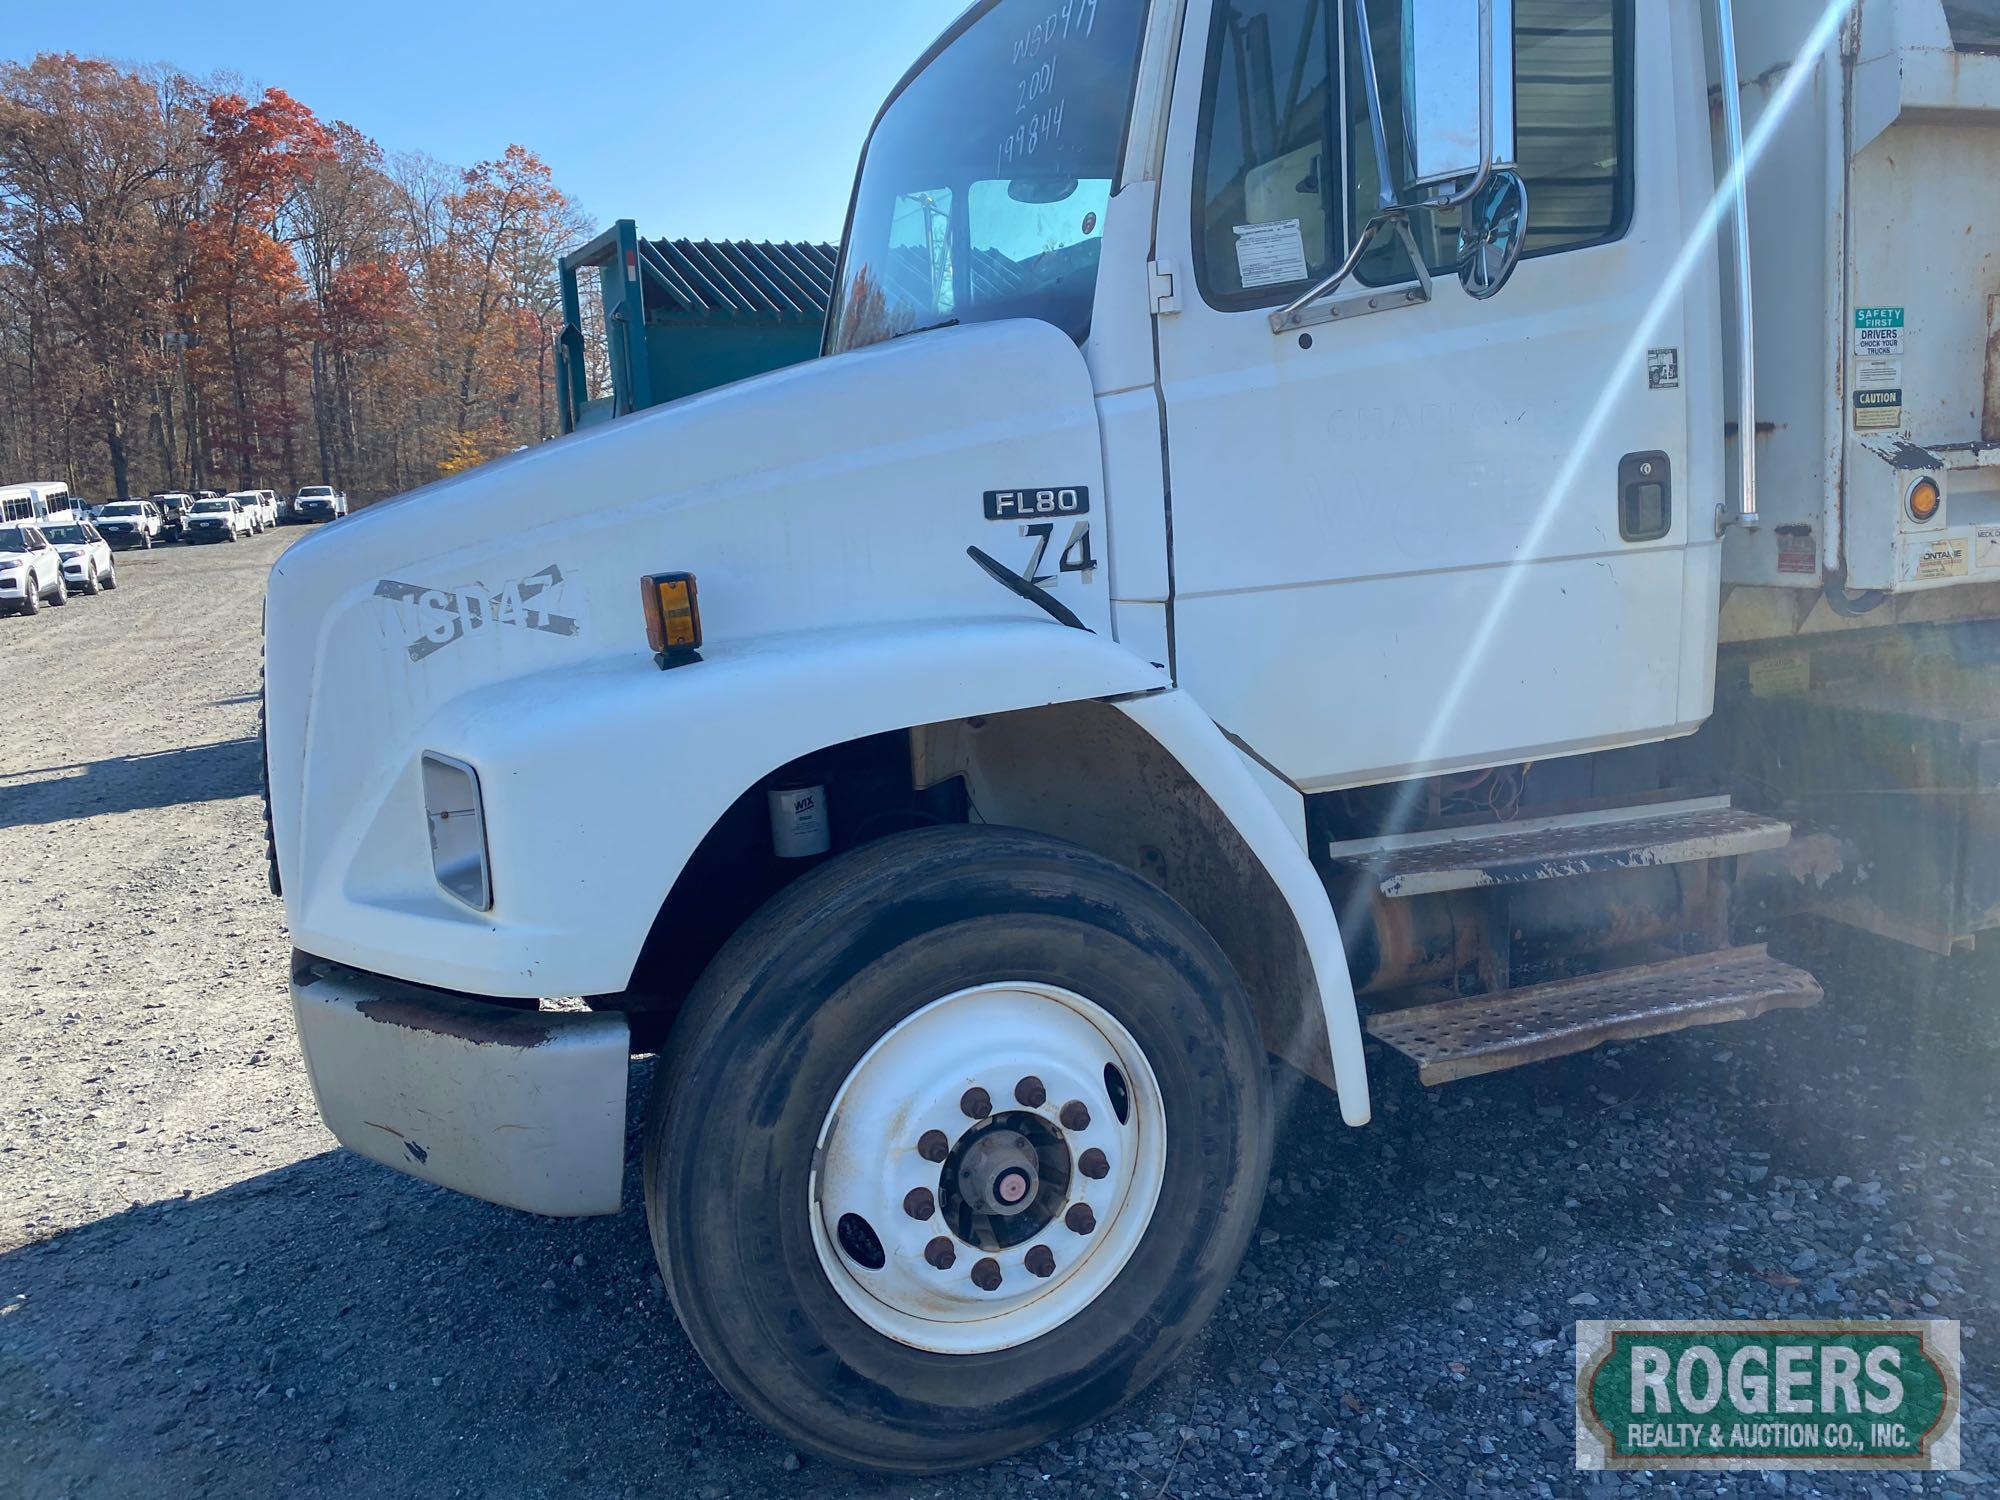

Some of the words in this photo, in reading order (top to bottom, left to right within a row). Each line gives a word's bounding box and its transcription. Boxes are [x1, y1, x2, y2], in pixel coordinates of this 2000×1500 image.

[1016, 56, 1056, 114] 2001
[998, 98, 1065, 178] 199844
[1858, 309, 1901, 321] SAFETY
[1865, 318, 1892, 327] FIRST
[1861, 329, 1897, 340] DRIVERS
[1860, 340, 1880, 348] CHOCK
[1882, 339, 1898, 347] YOUR
[1867, 347, 1891, 355] TRUCKS
[1859, 392, 1896, 404] CAUTION
[995, 489, 1078, 515] FL80
[793, 796, 814, 811] WIX
